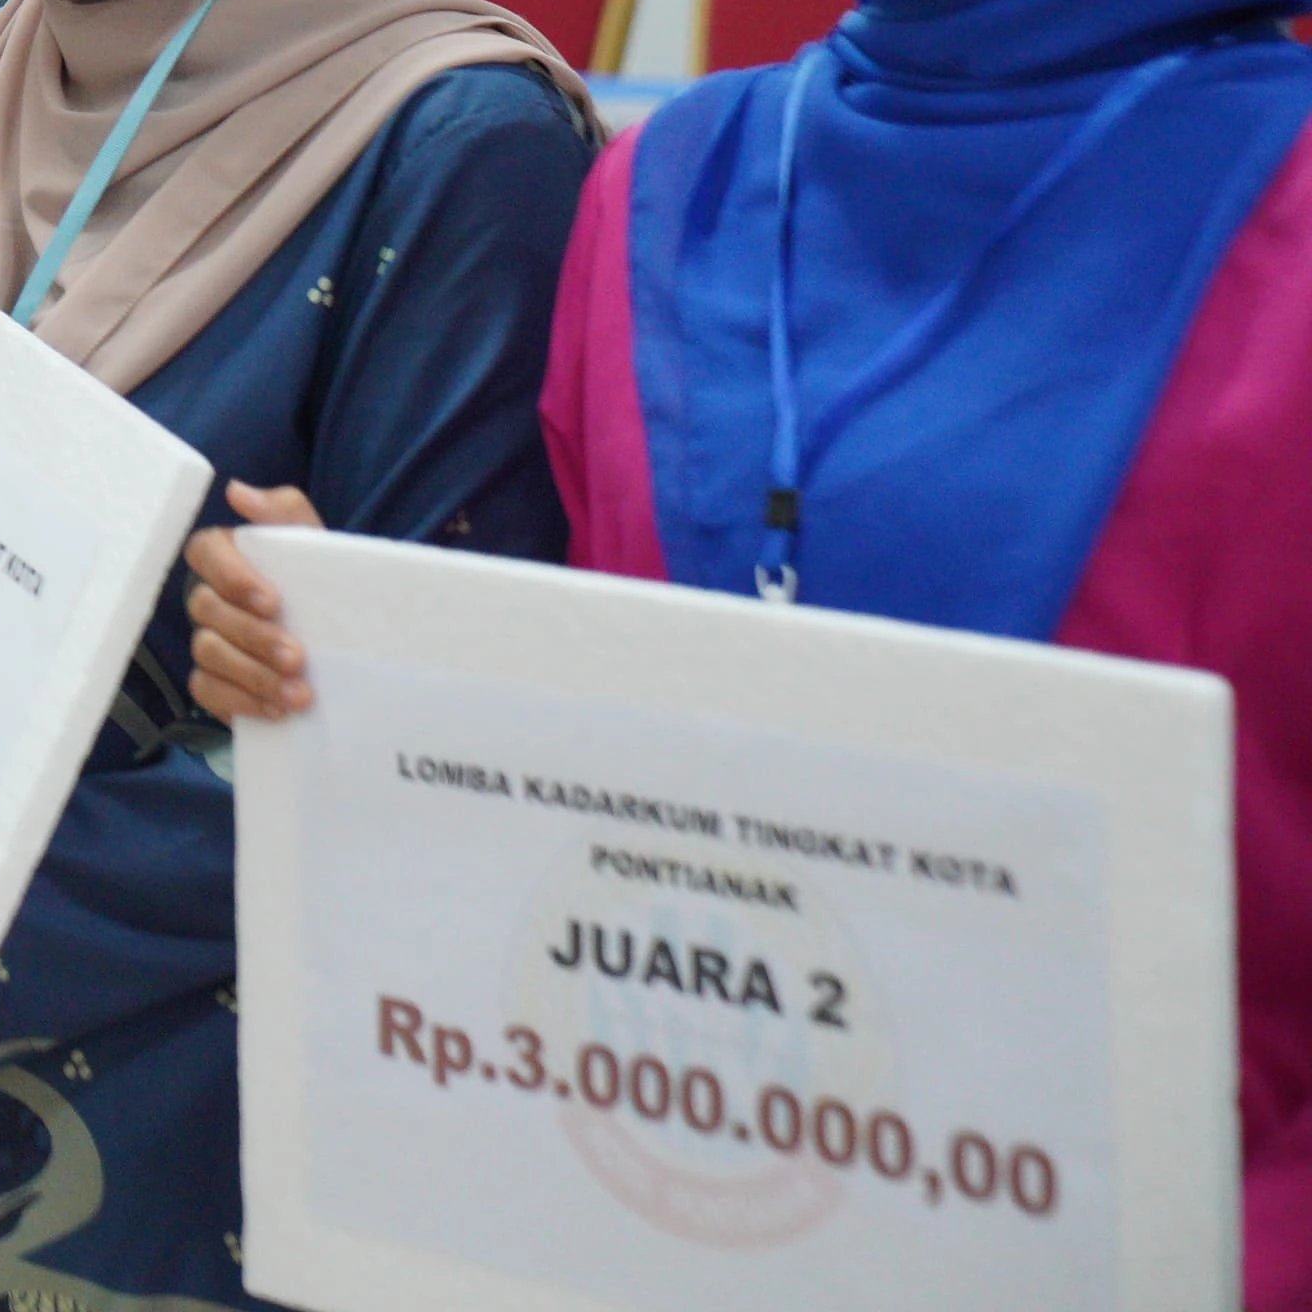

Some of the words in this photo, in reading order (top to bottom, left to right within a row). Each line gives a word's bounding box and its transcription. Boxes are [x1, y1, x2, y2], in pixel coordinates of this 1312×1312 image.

[4, 547, 44, 598] KOTA
[397, 752, 513, 801] LOMBA
[524, 772, 724, 840] KADARKUM
[733, 815, 896, 876] TINGKAT
[910, 849, 1019, 900] KOTA
[590, 845, 798, 914] PONTIANAK
[549, 918, 782, 1018] JUARA
[807, 972, 851, 1030] 2
[378, 994, 1058, 1218] Rp.3.000.000,00
